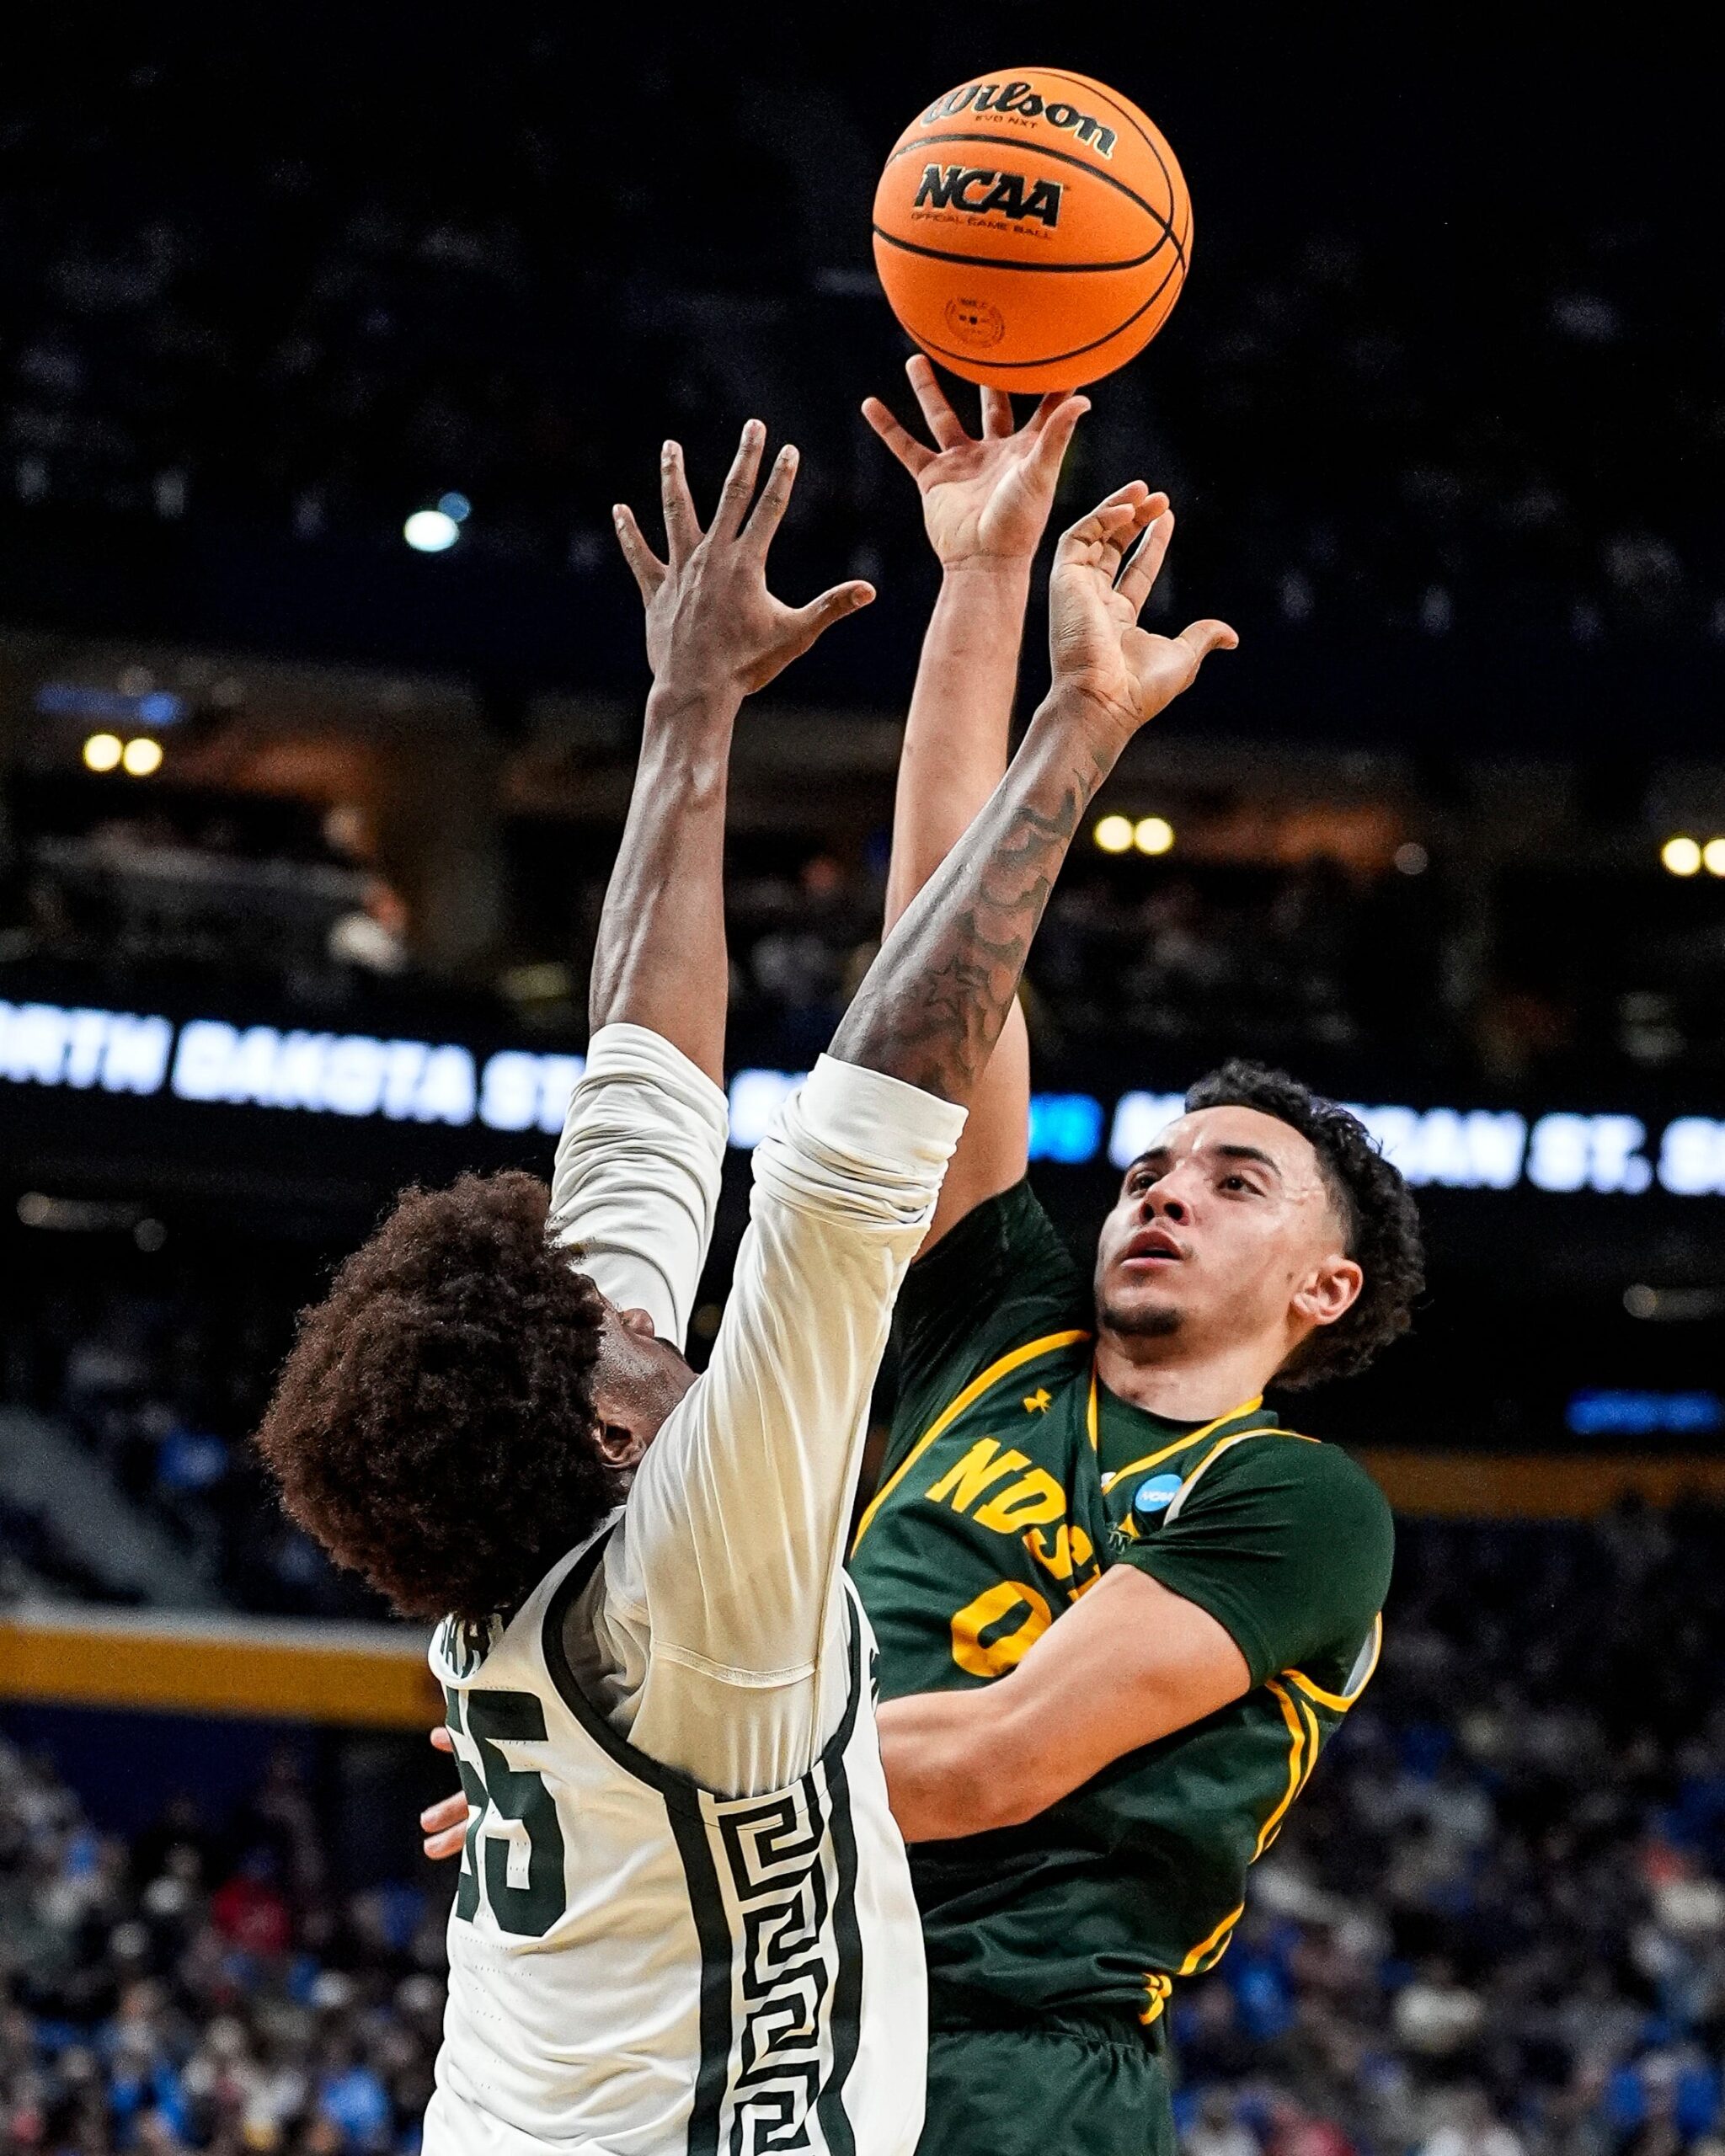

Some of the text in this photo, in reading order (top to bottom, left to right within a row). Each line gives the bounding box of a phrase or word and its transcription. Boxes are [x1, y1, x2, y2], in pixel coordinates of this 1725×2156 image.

[921, 81, 1118, 160] Wilson
[975, 114, 1039, 130] EVO NXT
[911, 212, 1053, 239] OFFICIAL GAME BALL
[912, 163, 1064, 232] NCAA
[951, 1581, 1052, 1678] 0
